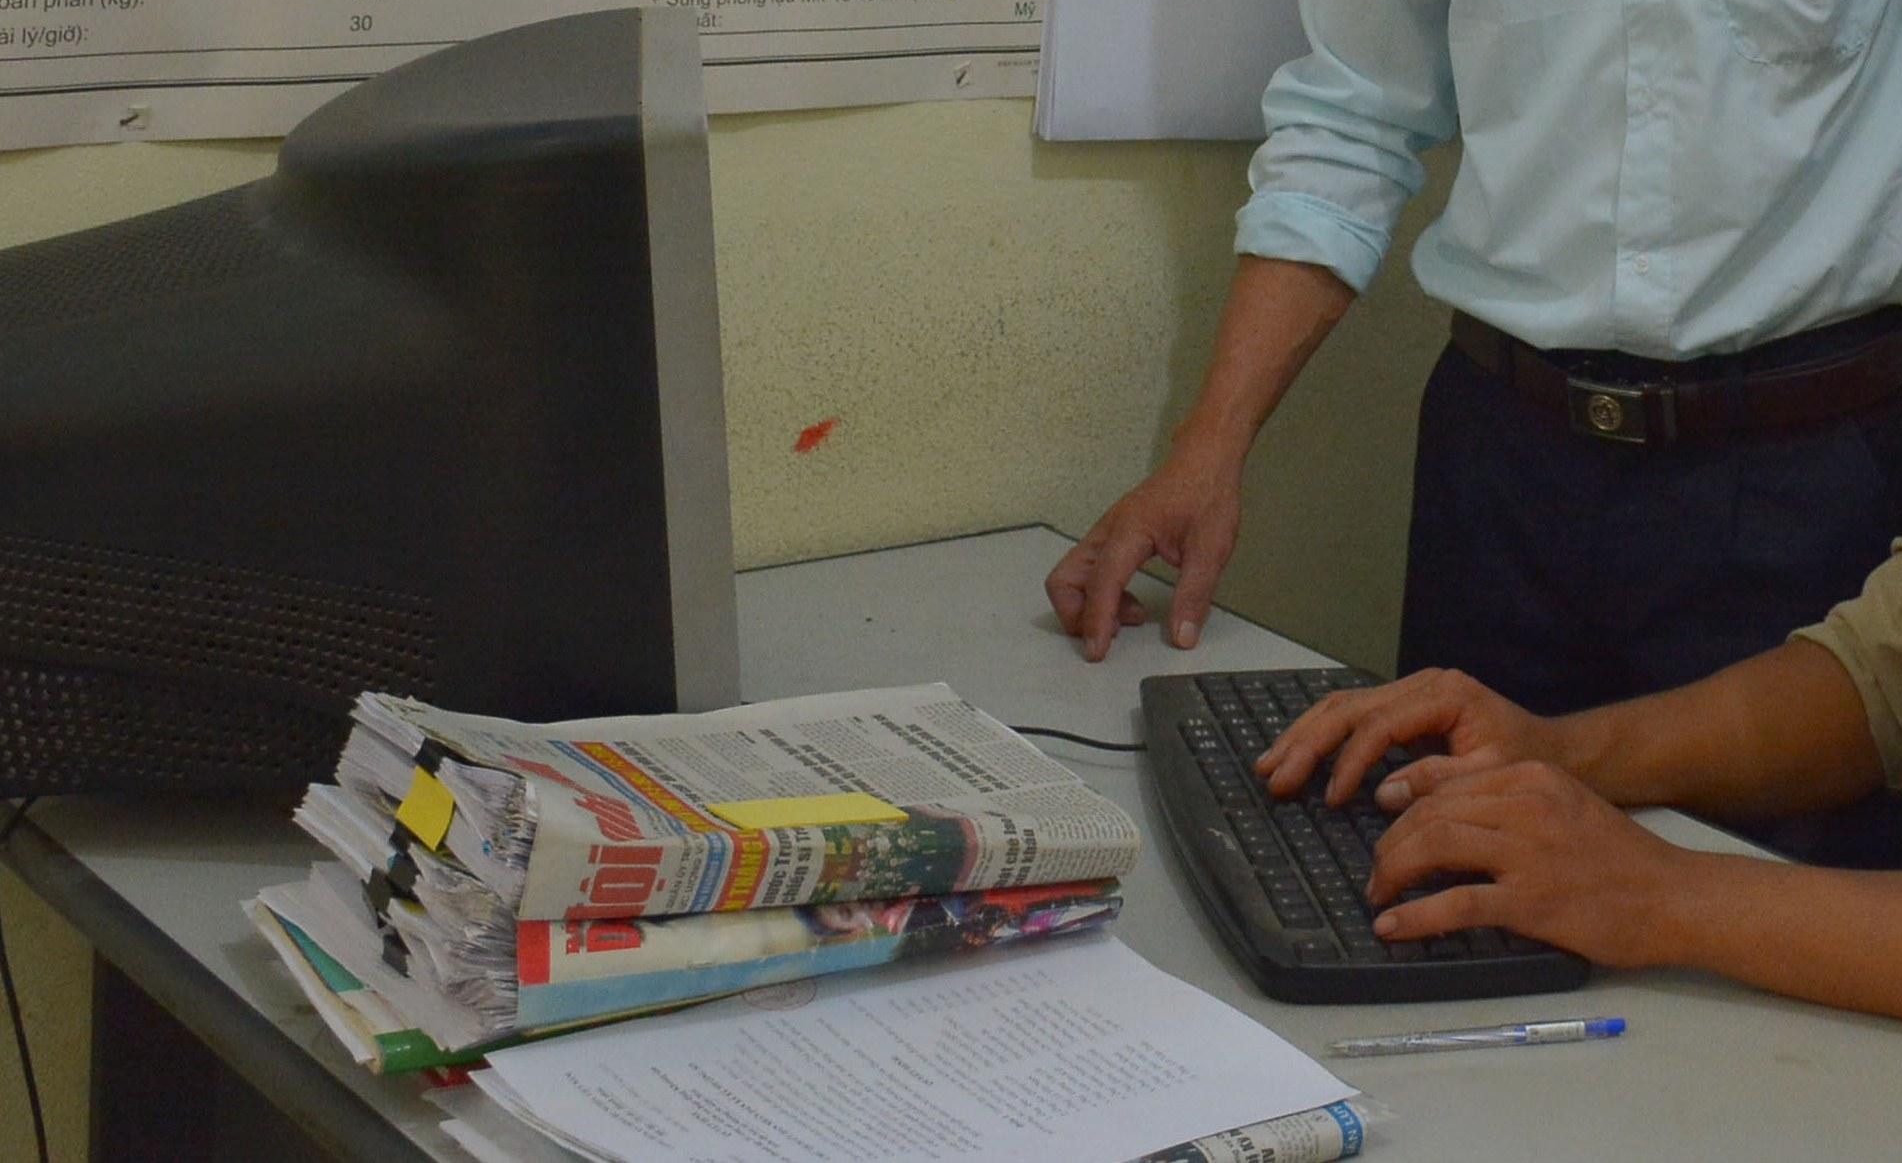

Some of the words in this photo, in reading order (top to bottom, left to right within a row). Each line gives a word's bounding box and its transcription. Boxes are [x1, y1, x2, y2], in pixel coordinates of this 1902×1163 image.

[1013, 1, 1036, 19] Mỹ
[349, 14, 374, 32] 30
[22, 25, 89, 48] lý/giờ):
